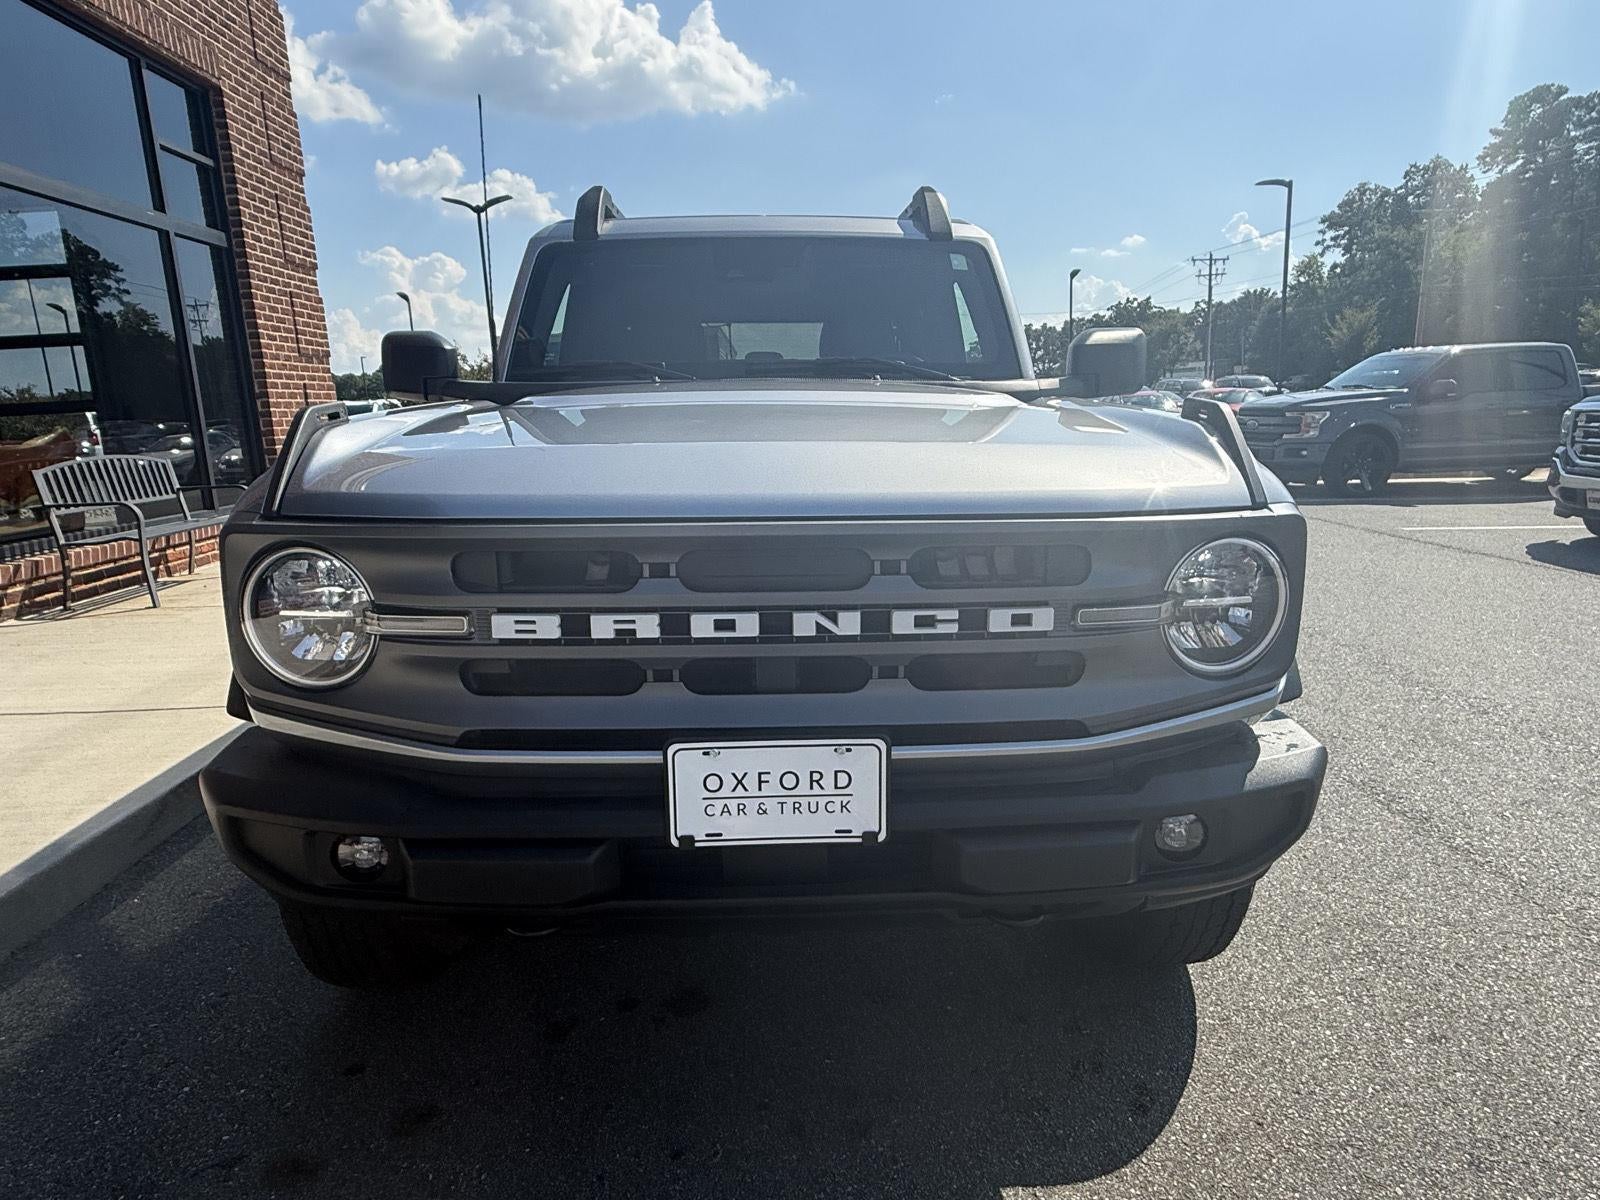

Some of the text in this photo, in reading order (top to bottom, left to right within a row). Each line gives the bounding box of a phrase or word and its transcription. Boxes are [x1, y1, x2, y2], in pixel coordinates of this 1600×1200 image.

[491, 607, 1055, 639] BRONCO
[702, 770, 853, 793] OXFORD
[703, 800, 852, 817] CAR & TRUCK
